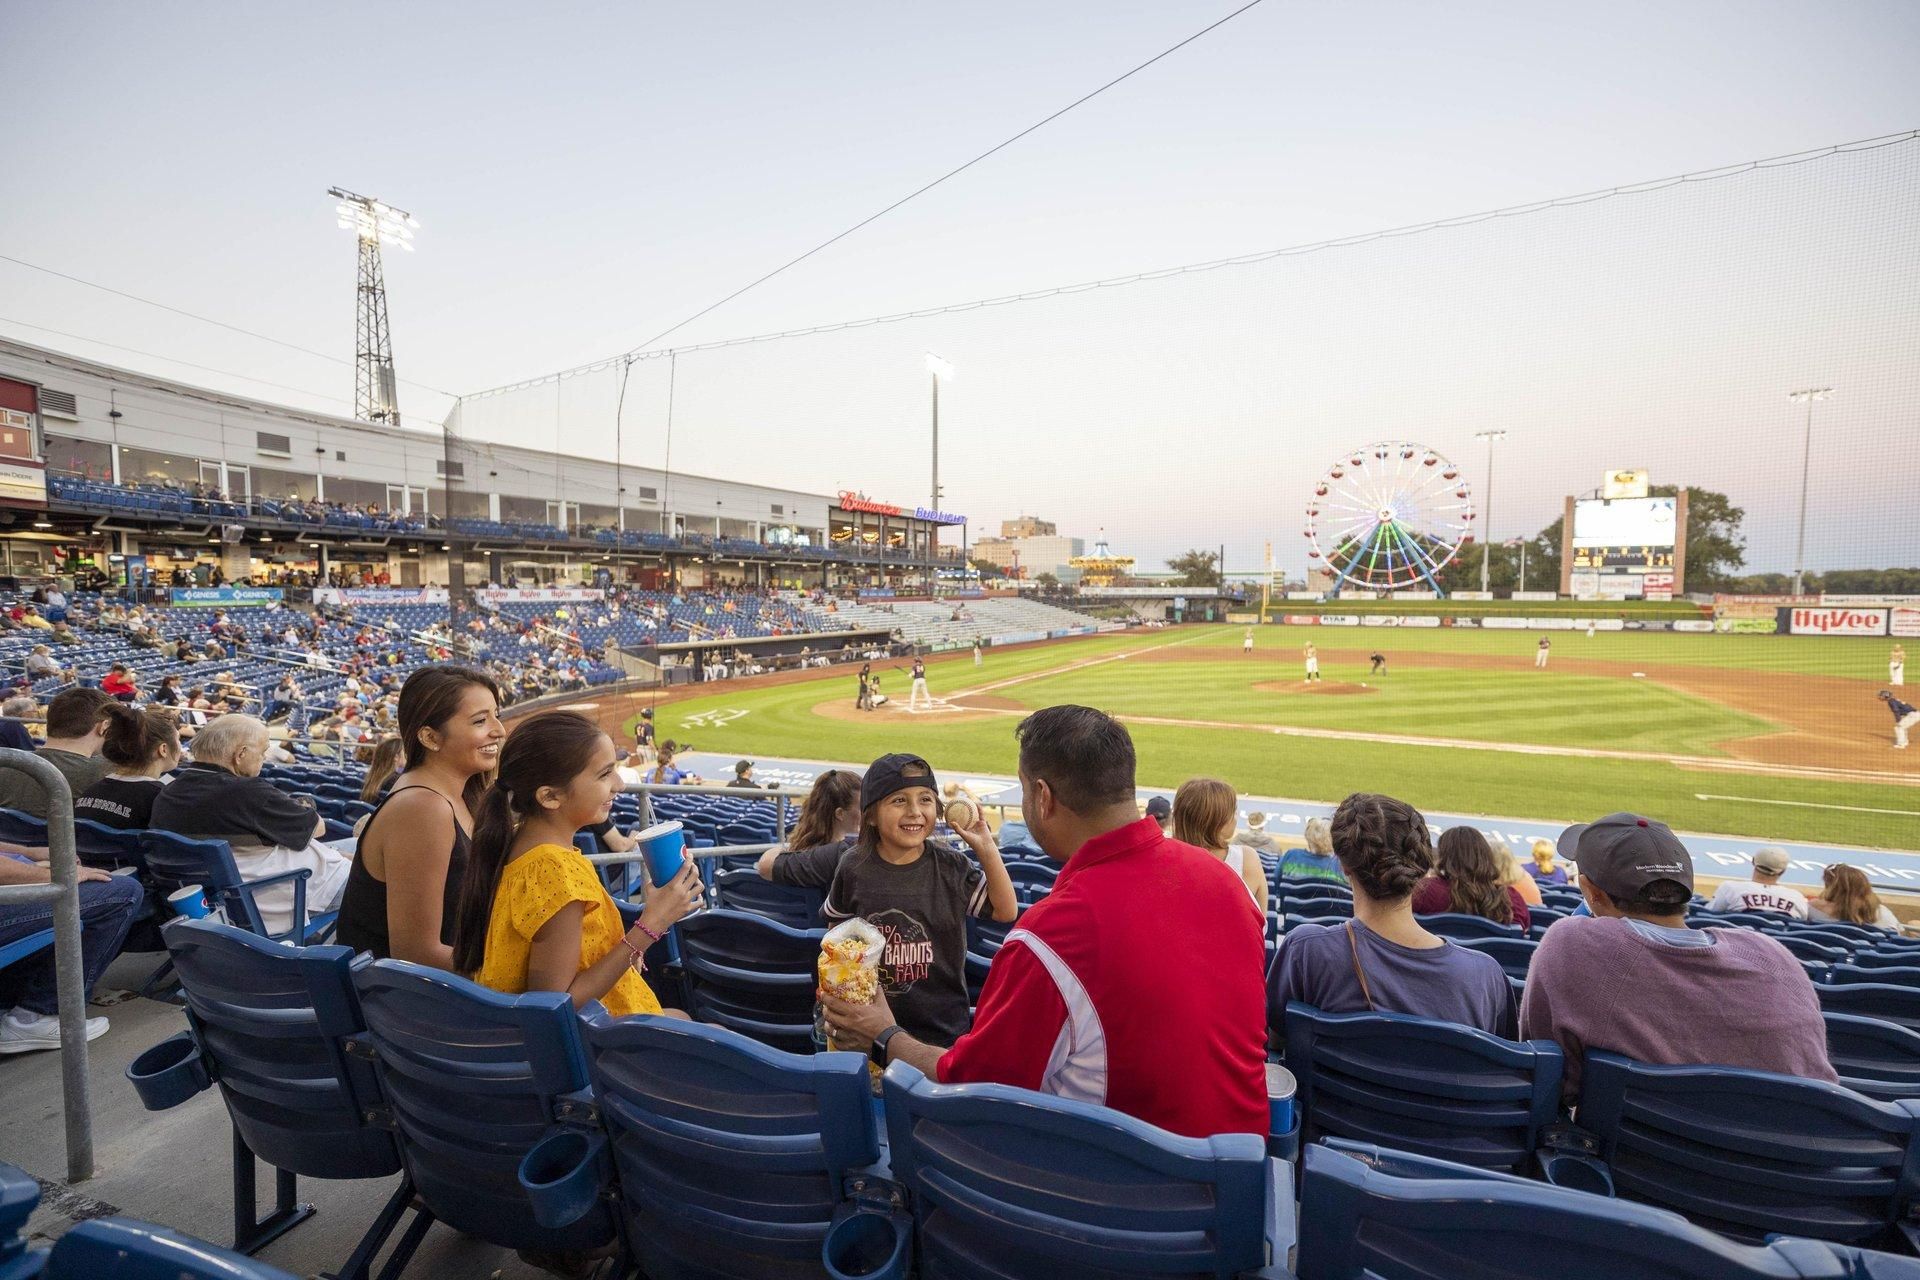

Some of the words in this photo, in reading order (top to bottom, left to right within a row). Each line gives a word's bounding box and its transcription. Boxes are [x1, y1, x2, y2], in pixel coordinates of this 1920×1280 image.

[838, 490, 902, 516] Budweiser
[915, 507, 938, 520] BUD
[938, 511, 967, 524] LIGHT
[192, 591, 220, 599] GENESIS
[1742, 894, 1794, 911] KEPLER
[885, 941, 934, 966] BANDITS
[896, 963, 929, 983] FAN
